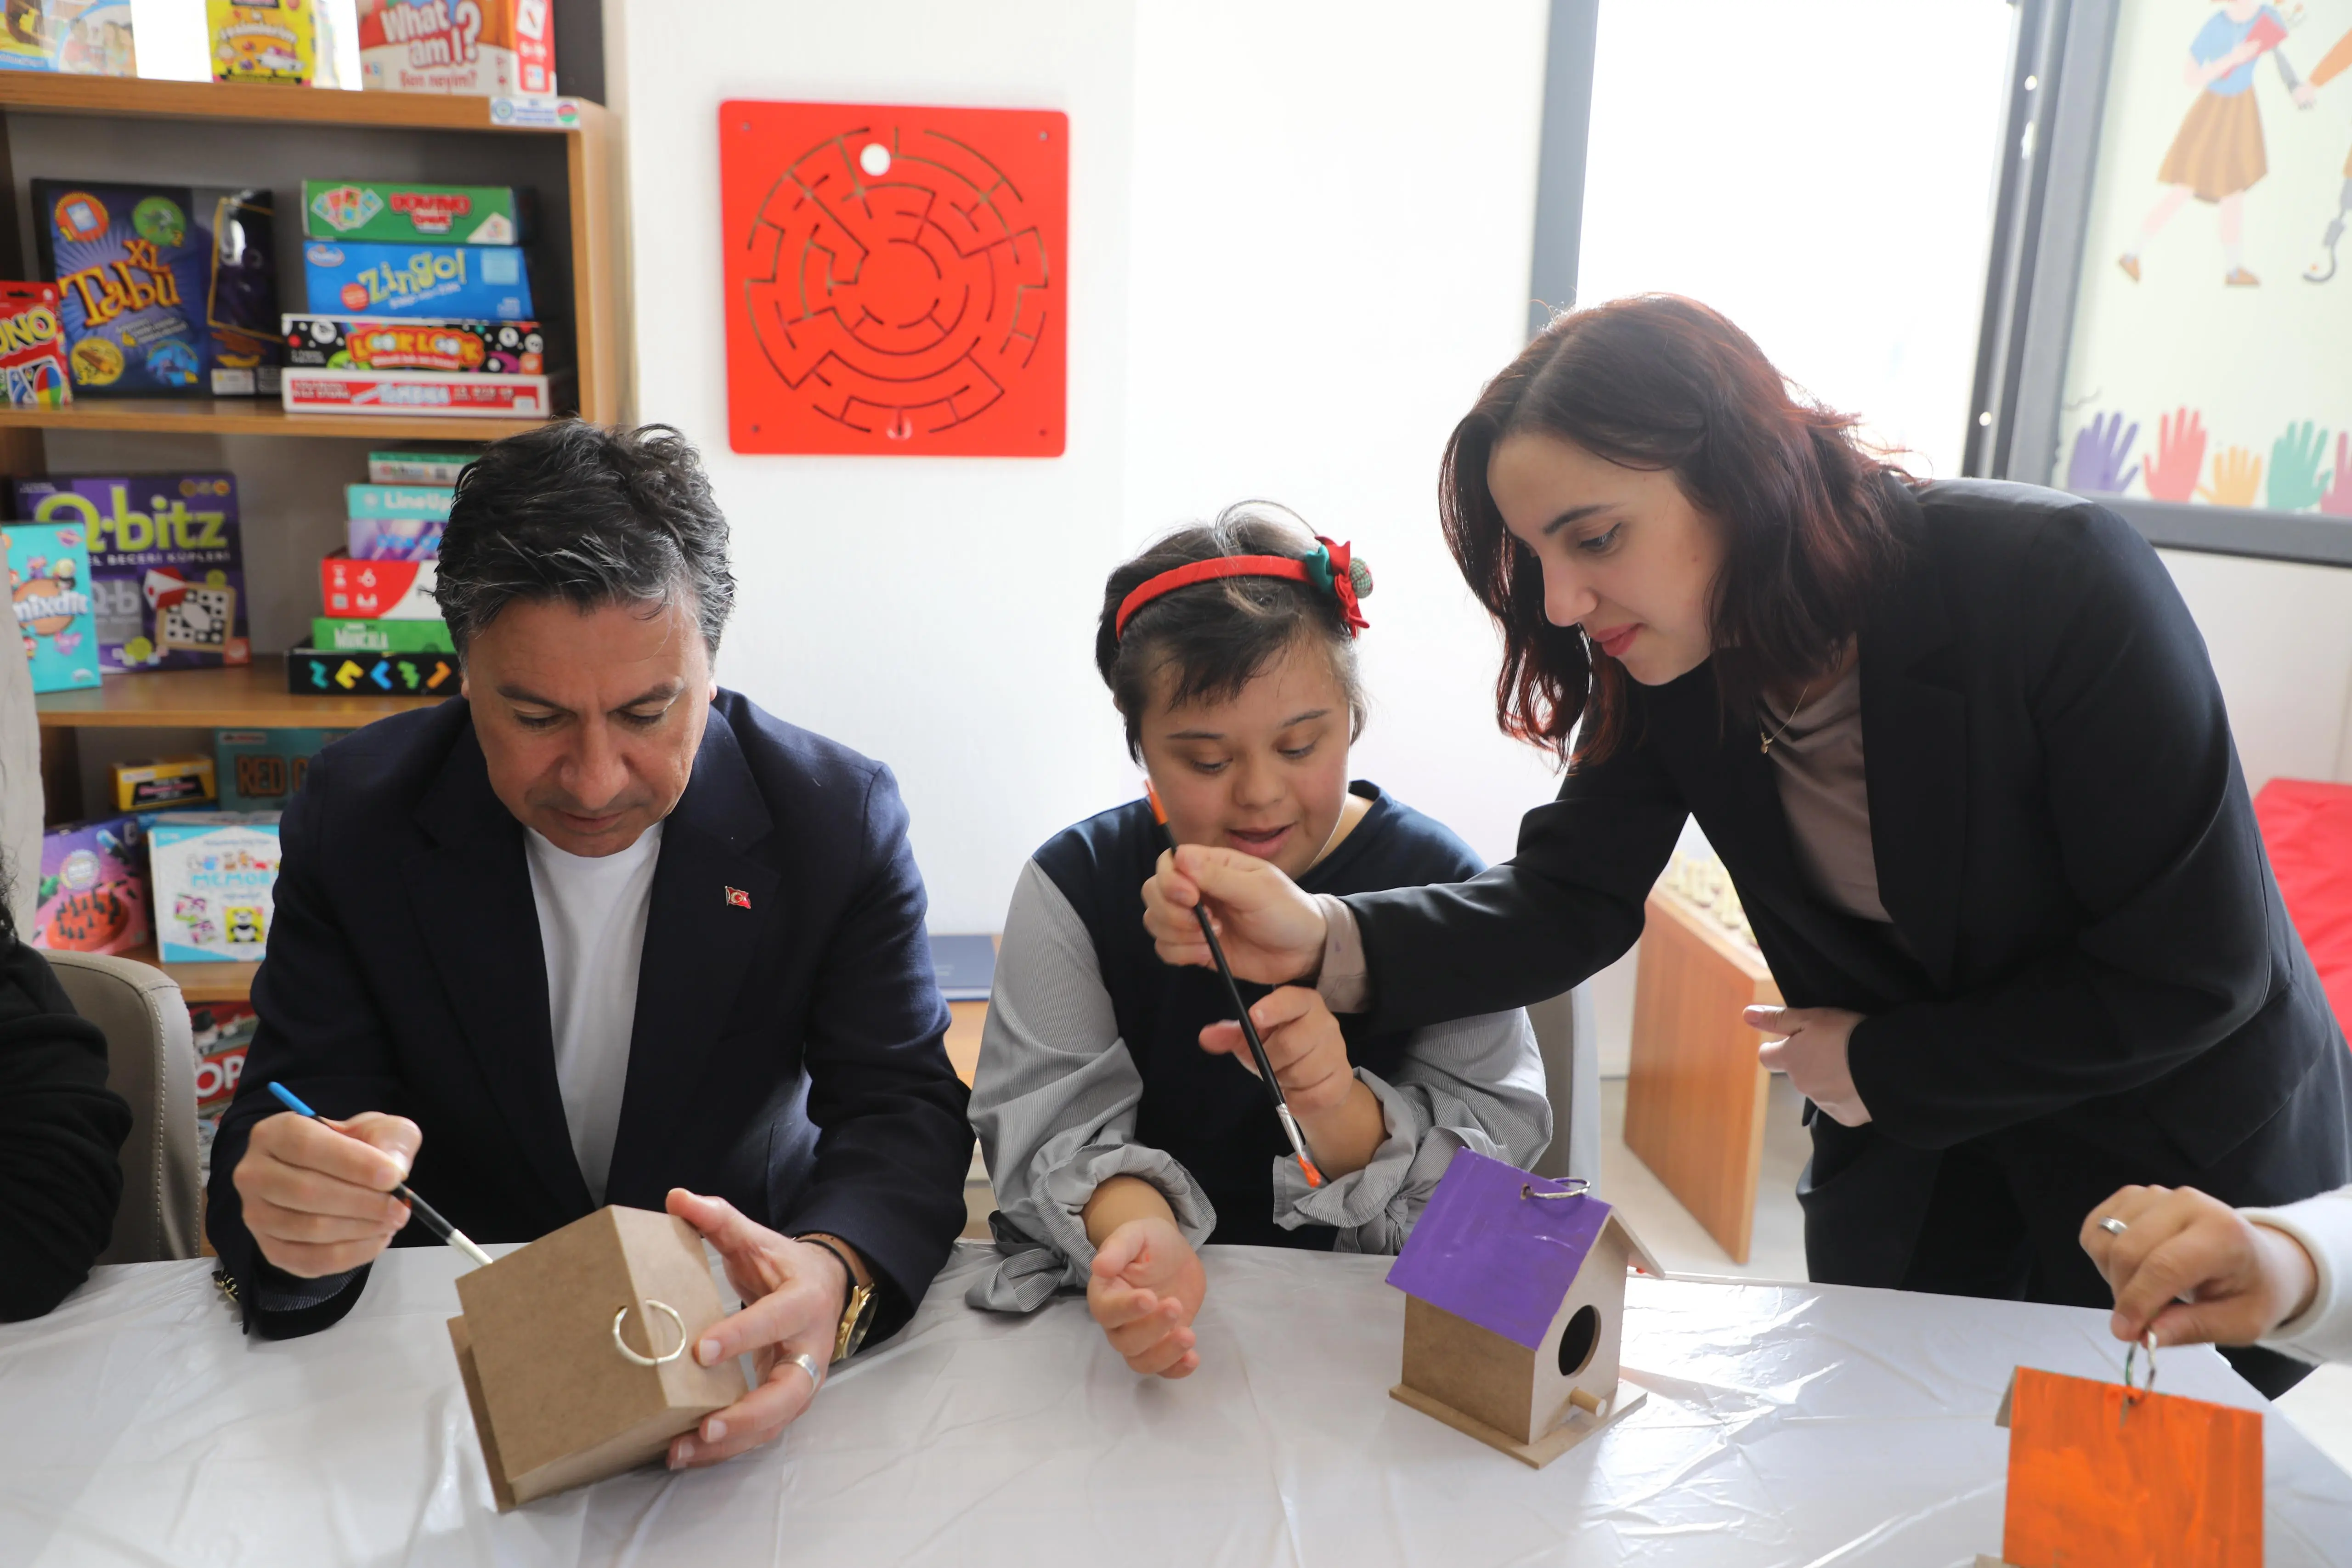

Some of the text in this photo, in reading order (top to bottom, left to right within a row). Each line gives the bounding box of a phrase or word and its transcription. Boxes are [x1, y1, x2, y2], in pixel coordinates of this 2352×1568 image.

[380, 0, 450, 43] What
[410, 37, 452, 68] am
[123, 238, 170, 273] XL
[357, 247, 467, 304] Zingo!
[353, 331, 414, 357] LOOK
[416, 331, 480, 363] LOOK
[192, 872, 279, 887] MEMOR
[196, 1055, 246, 1098] OP
